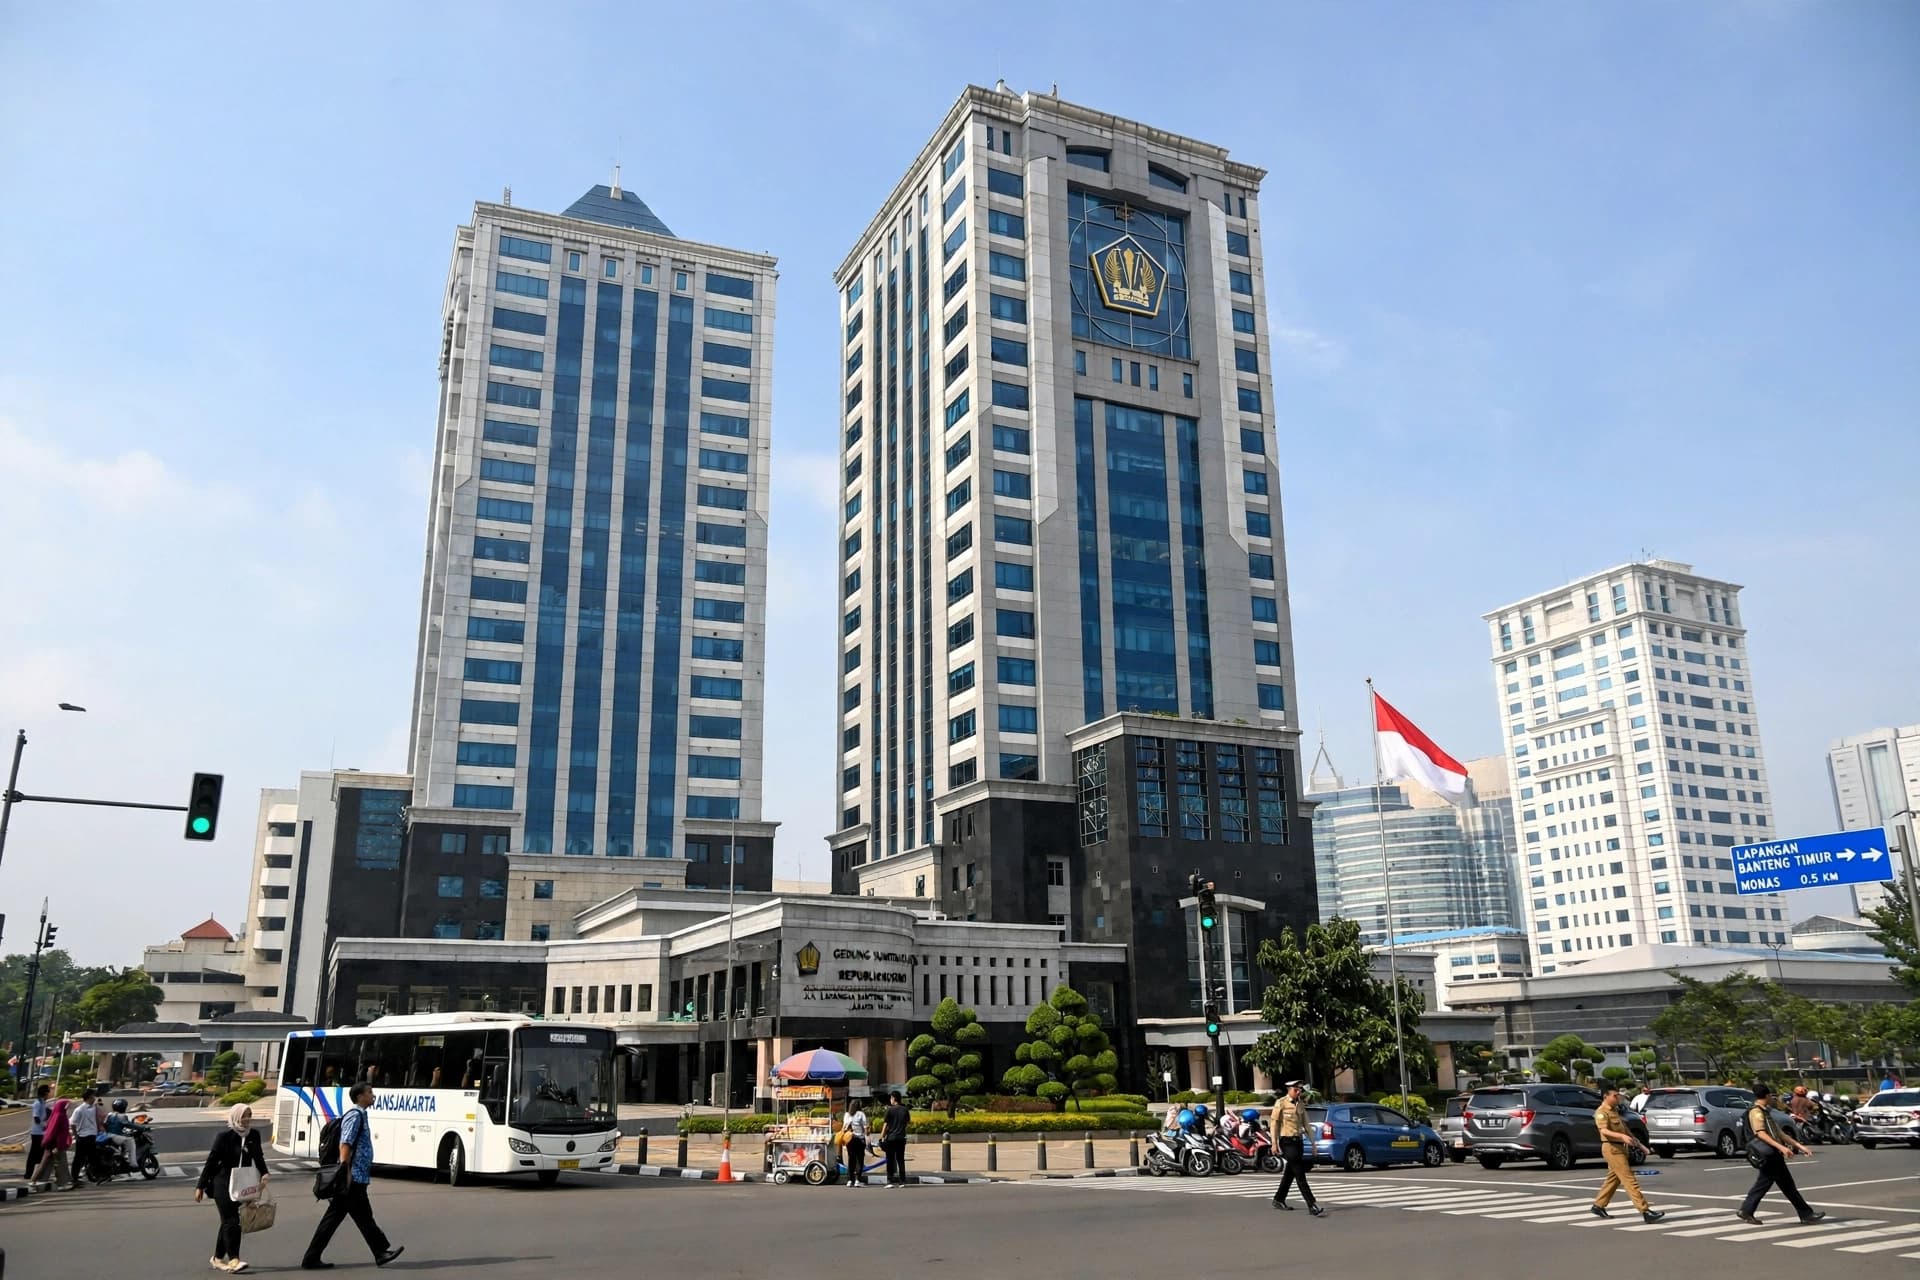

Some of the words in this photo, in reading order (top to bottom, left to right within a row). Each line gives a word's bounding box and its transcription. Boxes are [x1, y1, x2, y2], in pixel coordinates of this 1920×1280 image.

[1736, 842, 1798, 860] LAPANGAN
[1738, 859, 1791, 874] BANTENG
[1794, 852, 1833, 867] TIMUR
[1741, 876, 1781, 891] MONAS
[1800, 873, 1819, 885] 0.5
[1822, 871, 1839, 882] KM
[369, 1093, 436, 1113] RANSJAKARTA
